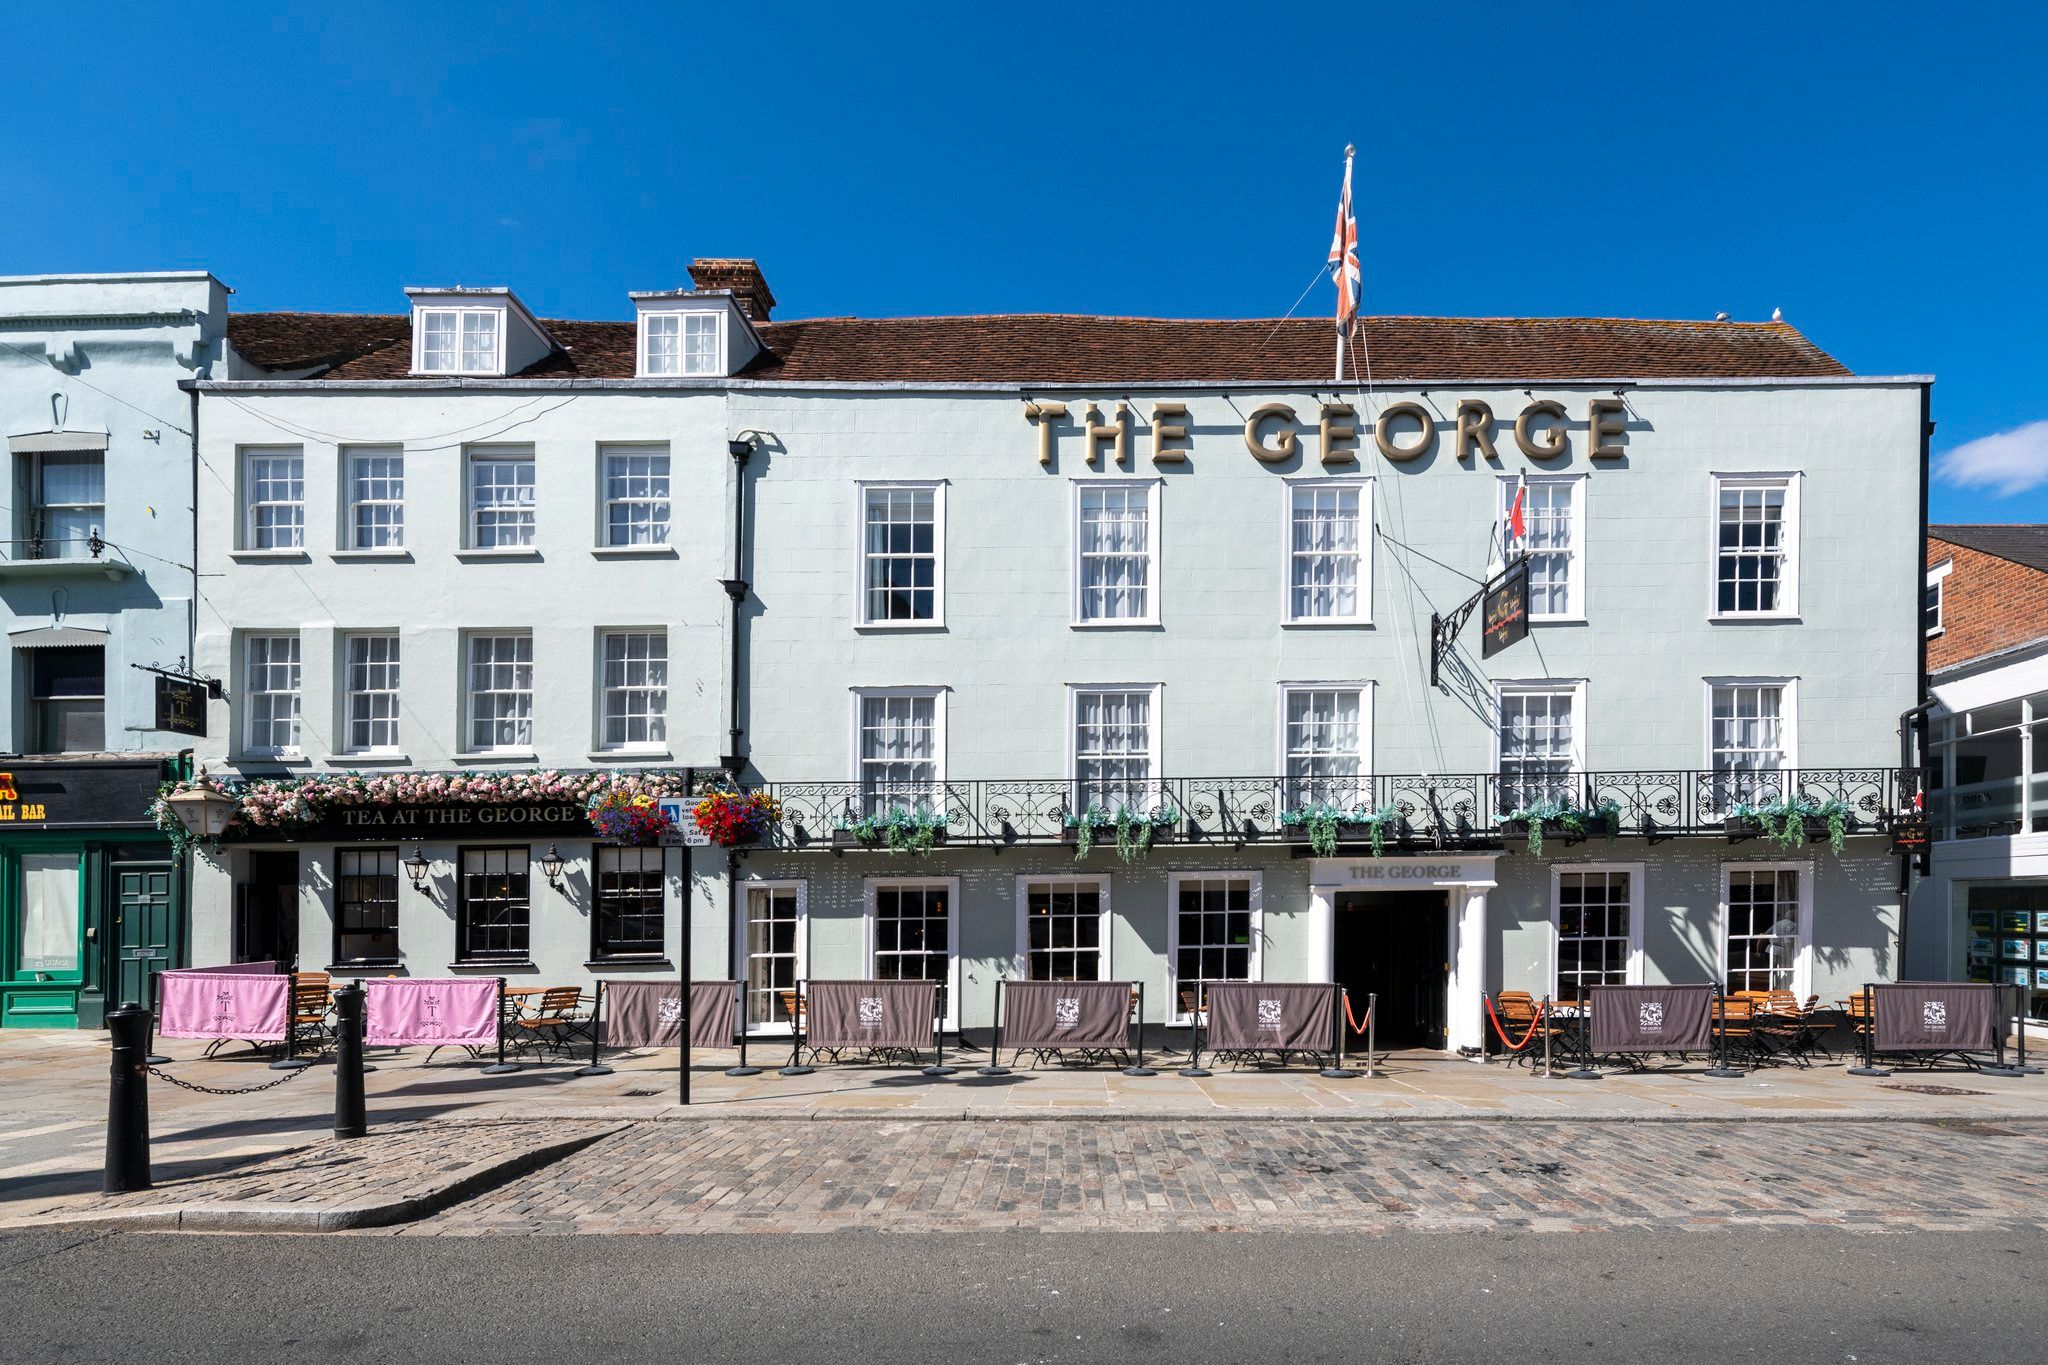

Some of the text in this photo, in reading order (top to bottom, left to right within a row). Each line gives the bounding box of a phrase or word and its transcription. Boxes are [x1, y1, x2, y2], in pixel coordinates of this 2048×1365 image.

[1024, 398, 1625, 464] THE GEORGE
[21, 804, 46, 820] BAR
[342, 806, 577, 825] TEA AT THE GEORGE
[1348, 865, 1462, 880] THE GEORGE
